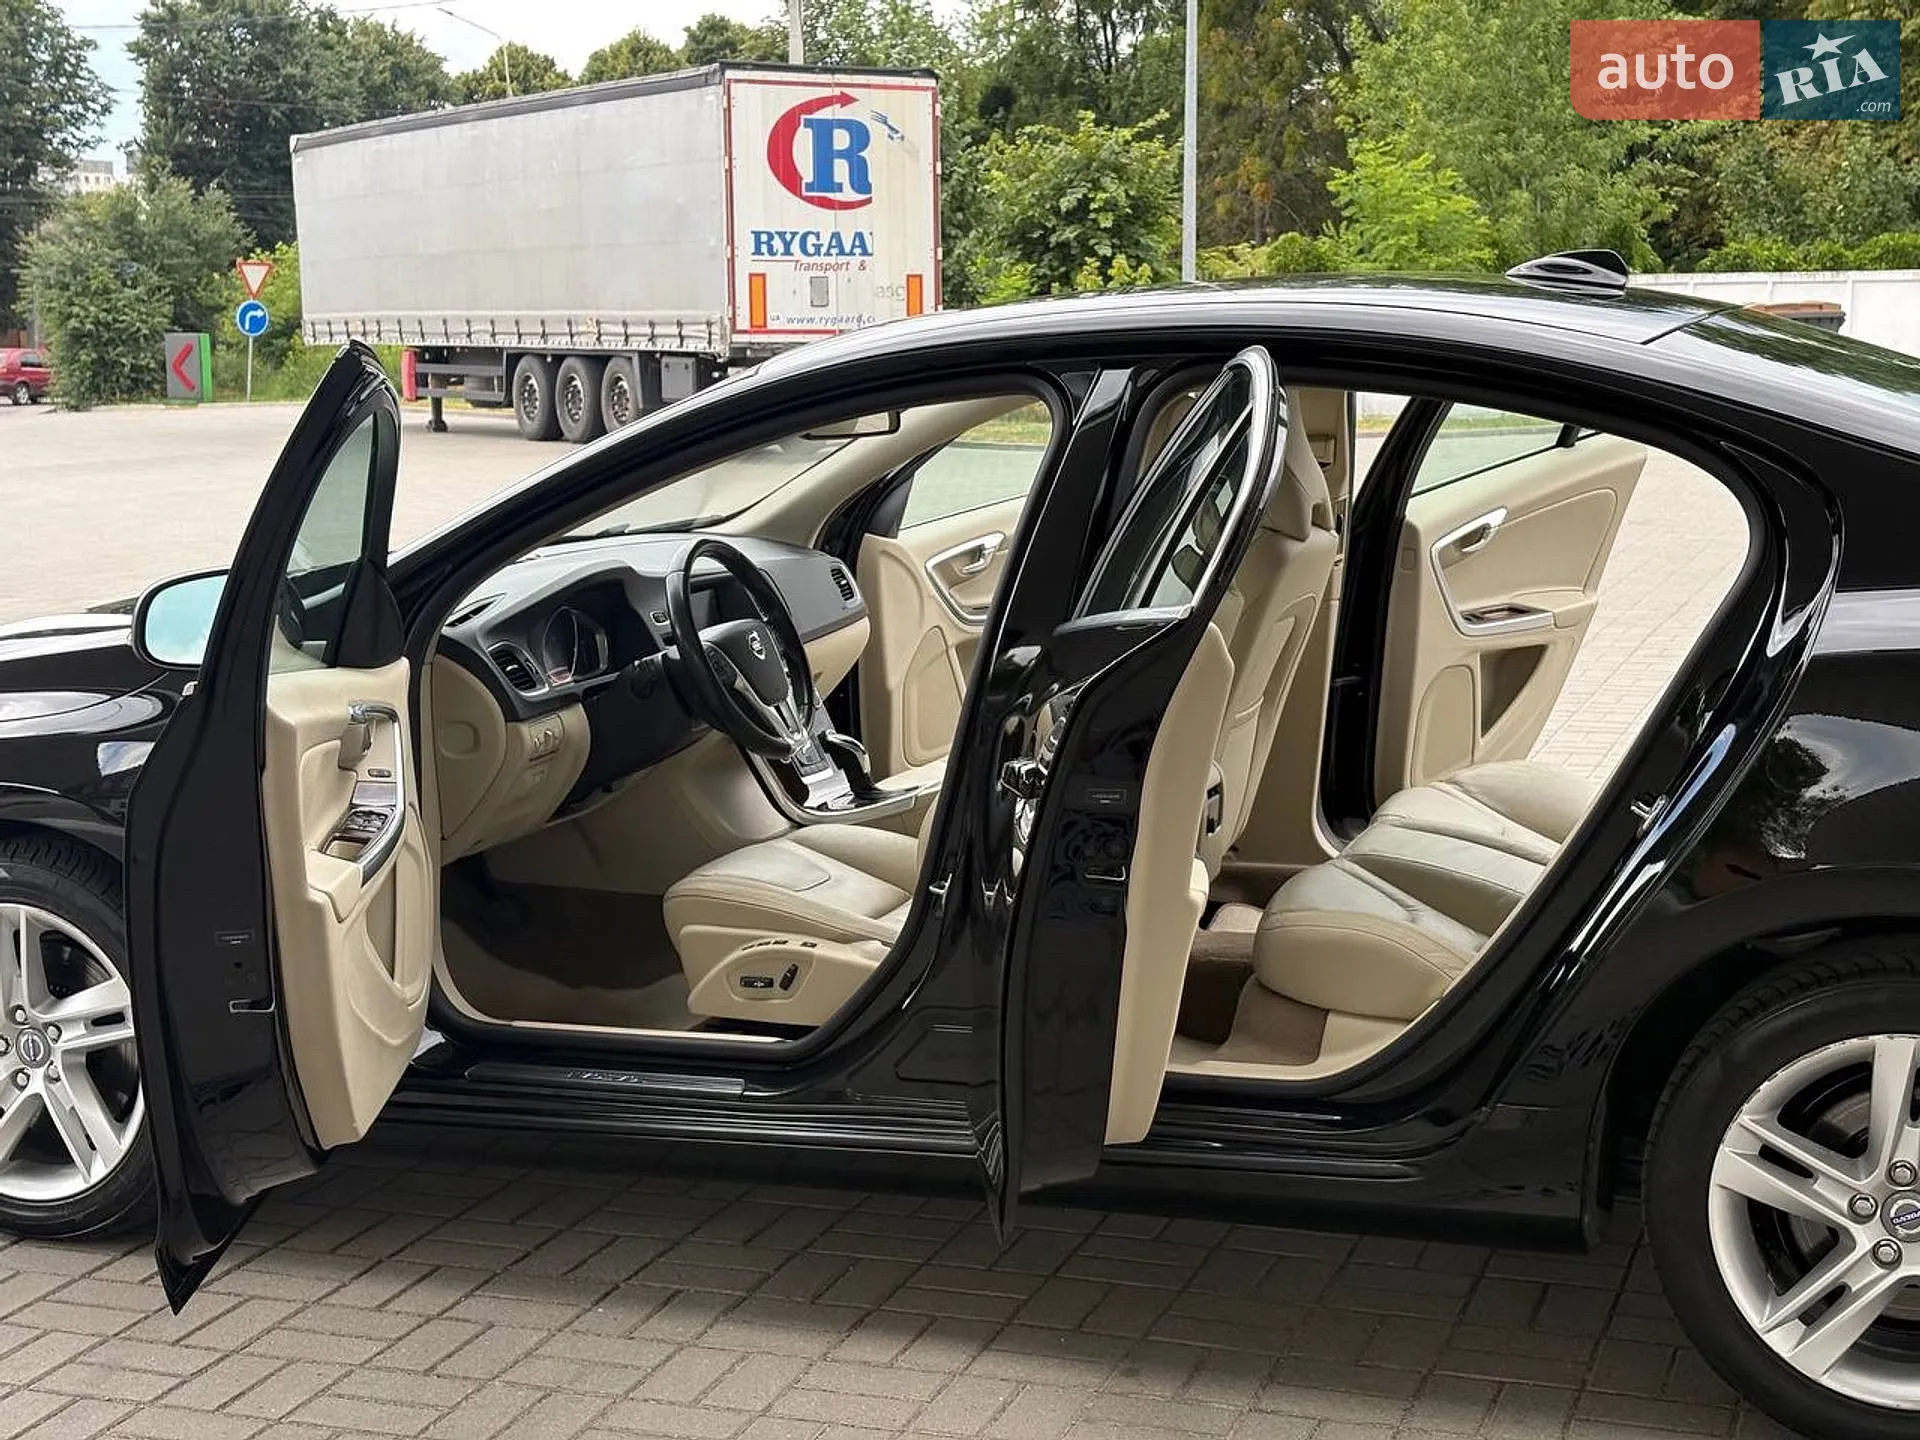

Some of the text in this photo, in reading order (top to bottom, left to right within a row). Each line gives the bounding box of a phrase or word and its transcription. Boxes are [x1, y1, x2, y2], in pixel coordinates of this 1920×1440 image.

[802, 117, 873, 195] R
[750, 230, 874, 257] RYGAA
[793, 259, 867, 273] Transport &
